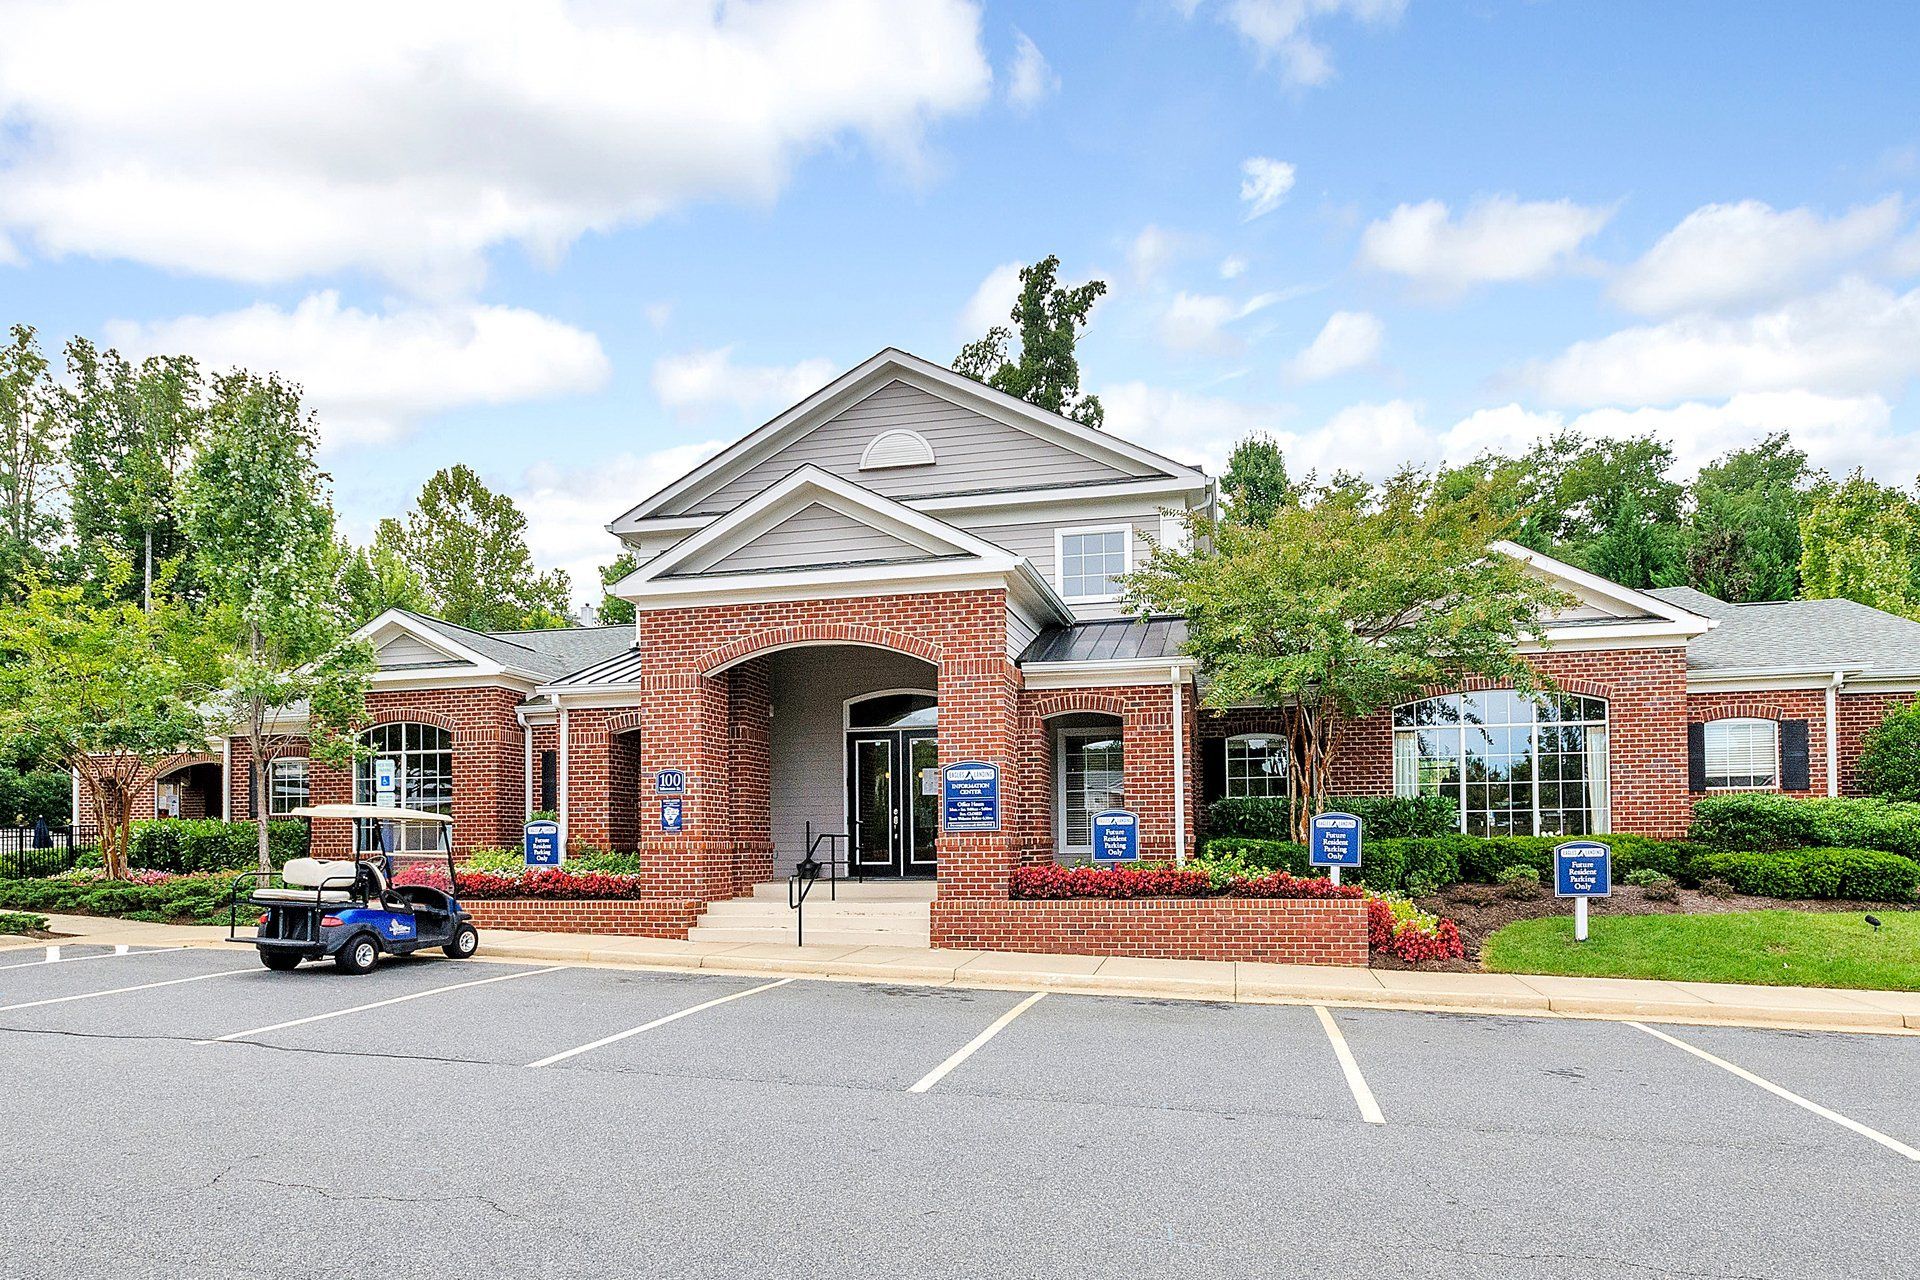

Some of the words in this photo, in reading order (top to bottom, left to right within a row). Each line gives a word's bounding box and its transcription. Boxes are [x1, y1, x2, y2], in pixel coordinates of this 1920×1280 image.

[660, 774, 682, 786] 100
[1108, 848, 1123, 856] Only
[1324, 846, 1348, 854] Parking
[1328, 852, 1344, 860] Only
[1570, 876, 1596, 884] Parking
[1574, 882, 1592, 891] Only
